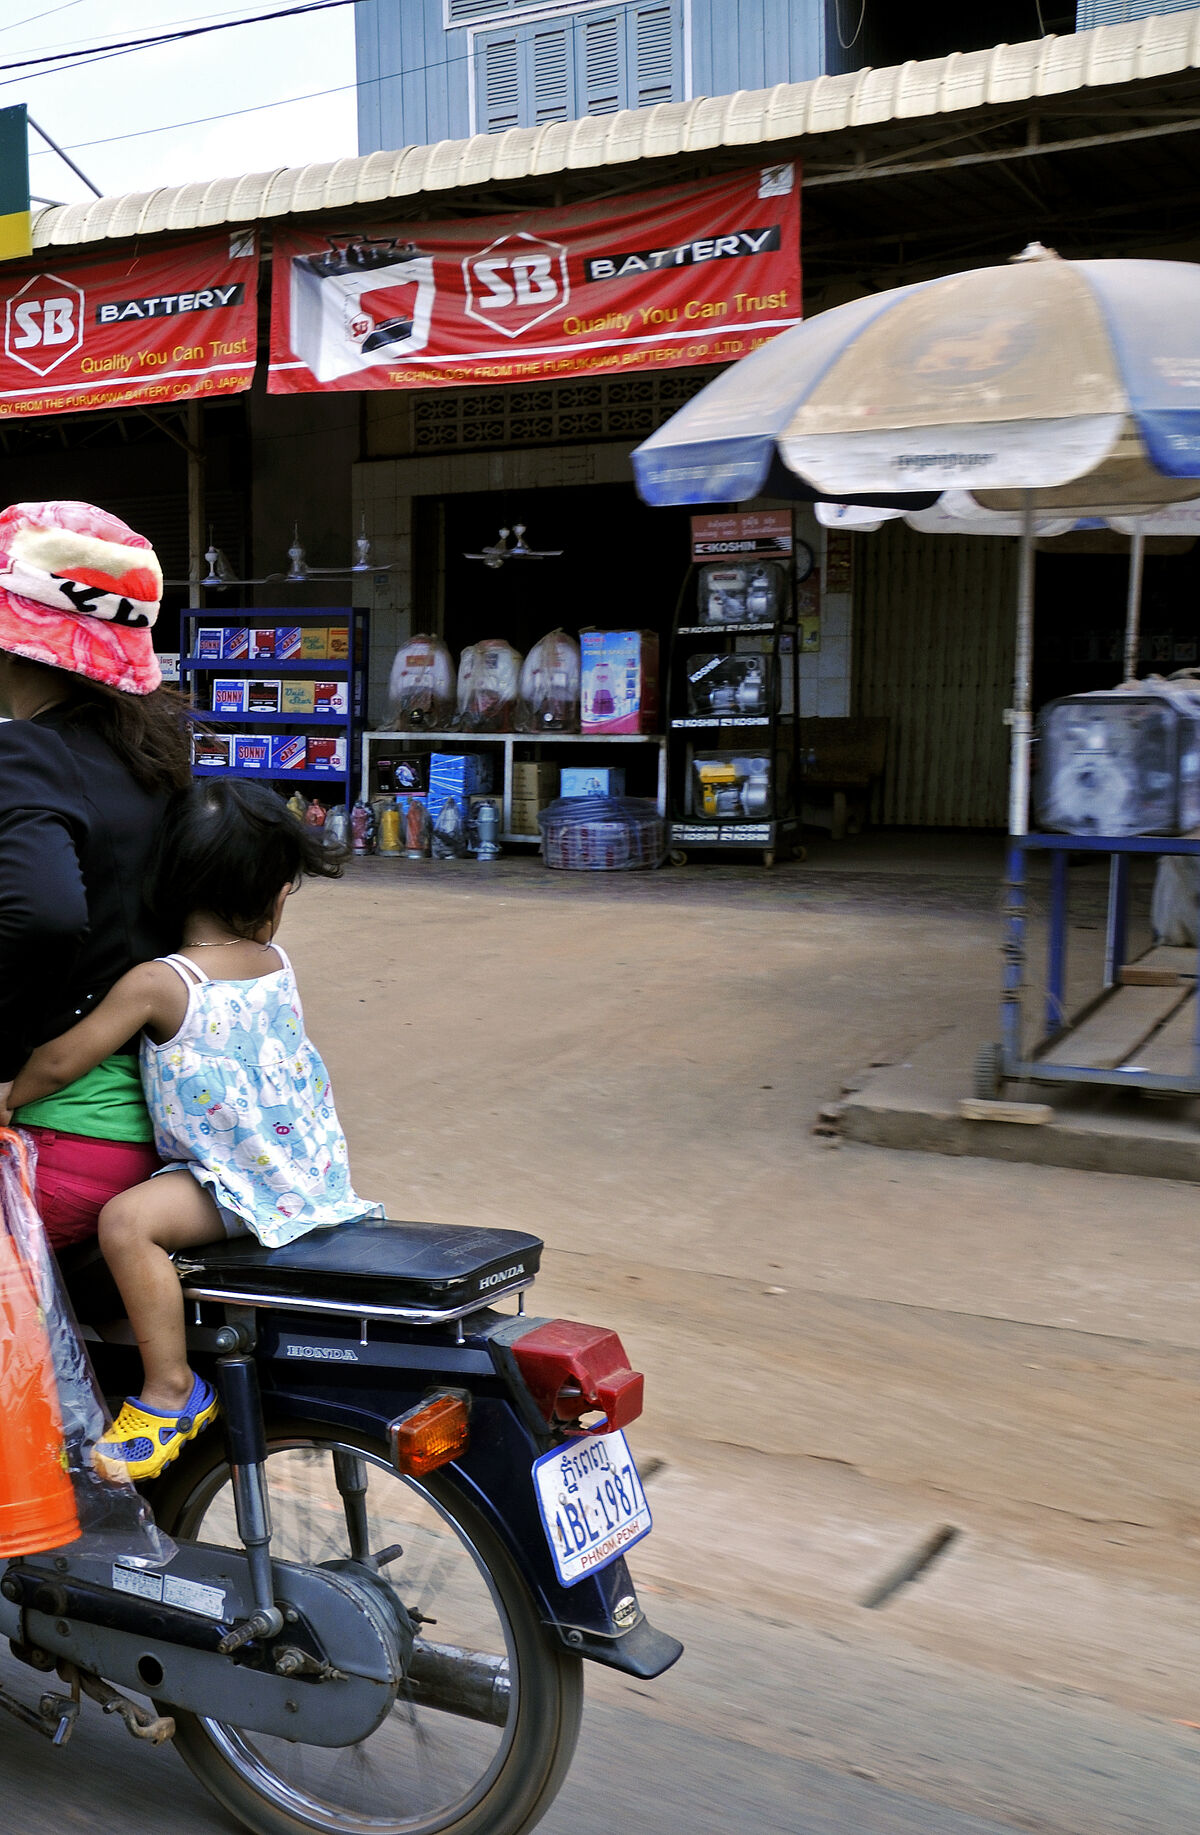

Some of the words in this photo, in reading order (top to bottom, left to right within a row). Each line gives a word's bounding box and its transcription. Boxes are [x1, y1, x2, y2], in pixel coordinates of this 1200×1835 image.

[590, 229, 773, 281] BATTERY
[478, 254, 558, 308] SB
[100, 286, 237, 323] BATTERY
[562, 309, 632, 336] Quality
[637, 305, 678, 325] You
[683, 300, 727, 321] Can
[733, 290, 788, 311] Trust
[14, 297, 75, 349] SB
[80, 353, 133, 374] Quality
[137, 347, 167, 366] You
[172, 344, 204, 361] Can
[210, 337, 248, 354] Trust
[389, 367, 473, 383] TECHNOLOGY
[474, 364, 512, 379] FROM
[514, 361, 540, 375] THE
[621, 348, 684, 365] BATTERY
[15, 401, 43, 413] FROM
[44, 397, 64, 409] THE
[65, 390, 124, 407] FURUKAWA
[125, 384, 171, 401] BATTERY
[711, 541, 757, 553] KOSHIN
[739, 623, 775, 631] KOSHIN
[689, 657, 721, 684] KOSHIN
[216, 690, 243, 703] SONNY
[684, 719, 720, 728] KOSHIN
[733, 718, 769, 727] KOSHIN
[238, 746, 266, 759] SONNY
[683, 833, 719, 841] KOSHIN
[733, 833, 769, 841] KOSHIN
[733, 824, 770, 832] KOSHIN
[478, 1263, 525, 1290] HONDA
[286, 1345, 359, 1361] HONDA
[580, 1539, 617, 1568] PHNOM
[617, 1520, 640, 1544] PENH
